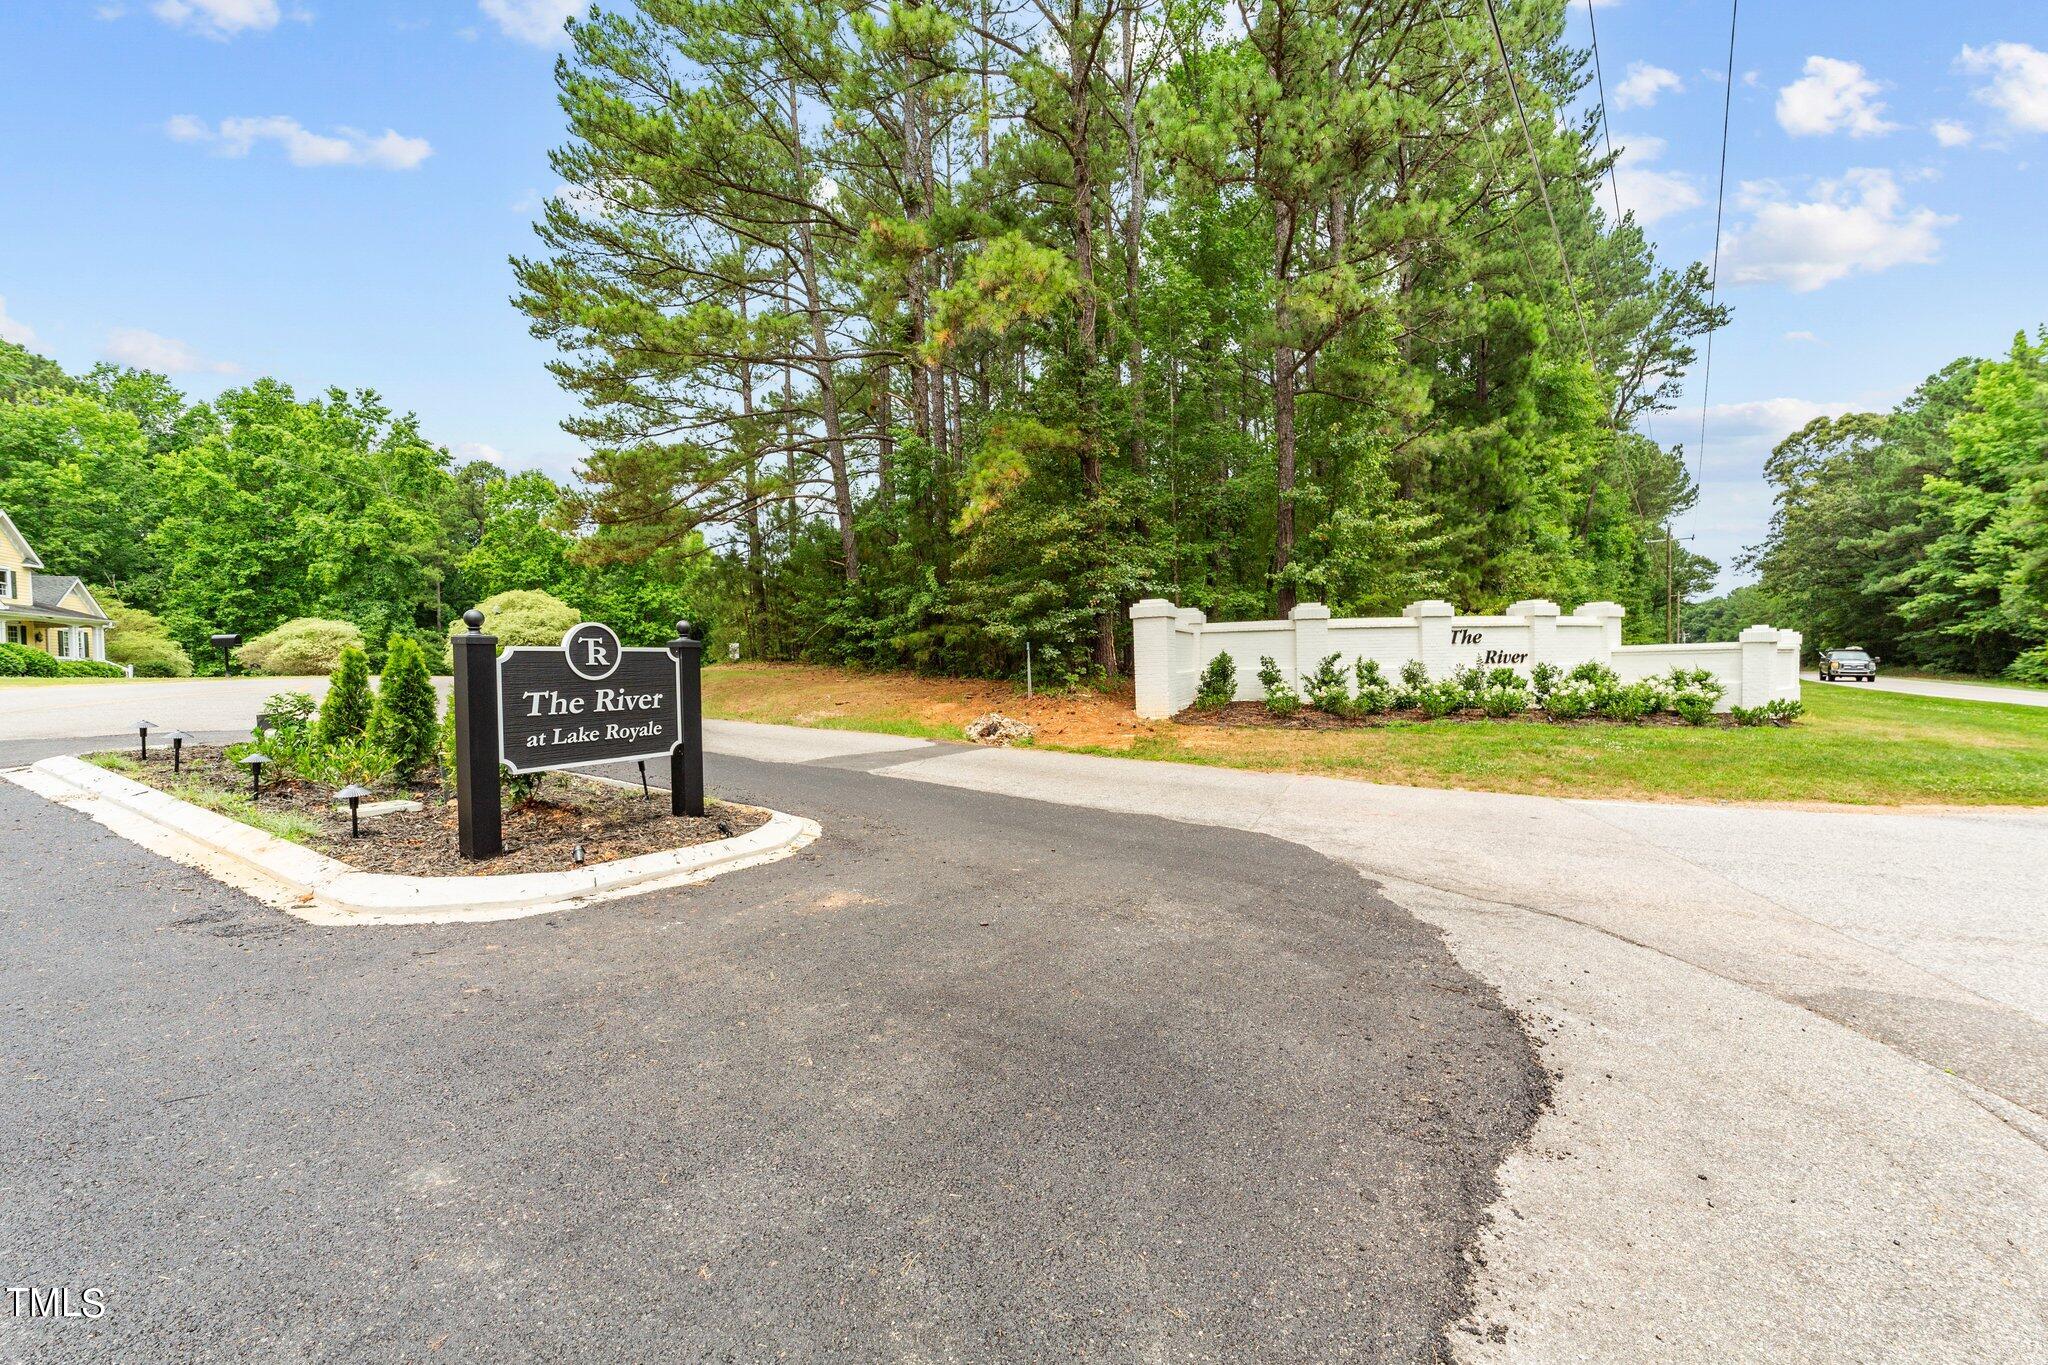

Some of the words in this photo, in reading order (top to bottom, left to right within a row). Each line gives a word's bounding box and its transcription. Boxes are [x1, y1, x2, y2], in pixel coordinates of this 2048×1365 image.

[1451, 629, 1483, 645] The
[1484, 650, 1528, 664] River
[522, 690, 585, 717] The
[593, 687, 663, 713] River
[526, 732, 547, 748] at
[551, 726, 600, 745] Lake
[604, 721, 663, 743] Royale
